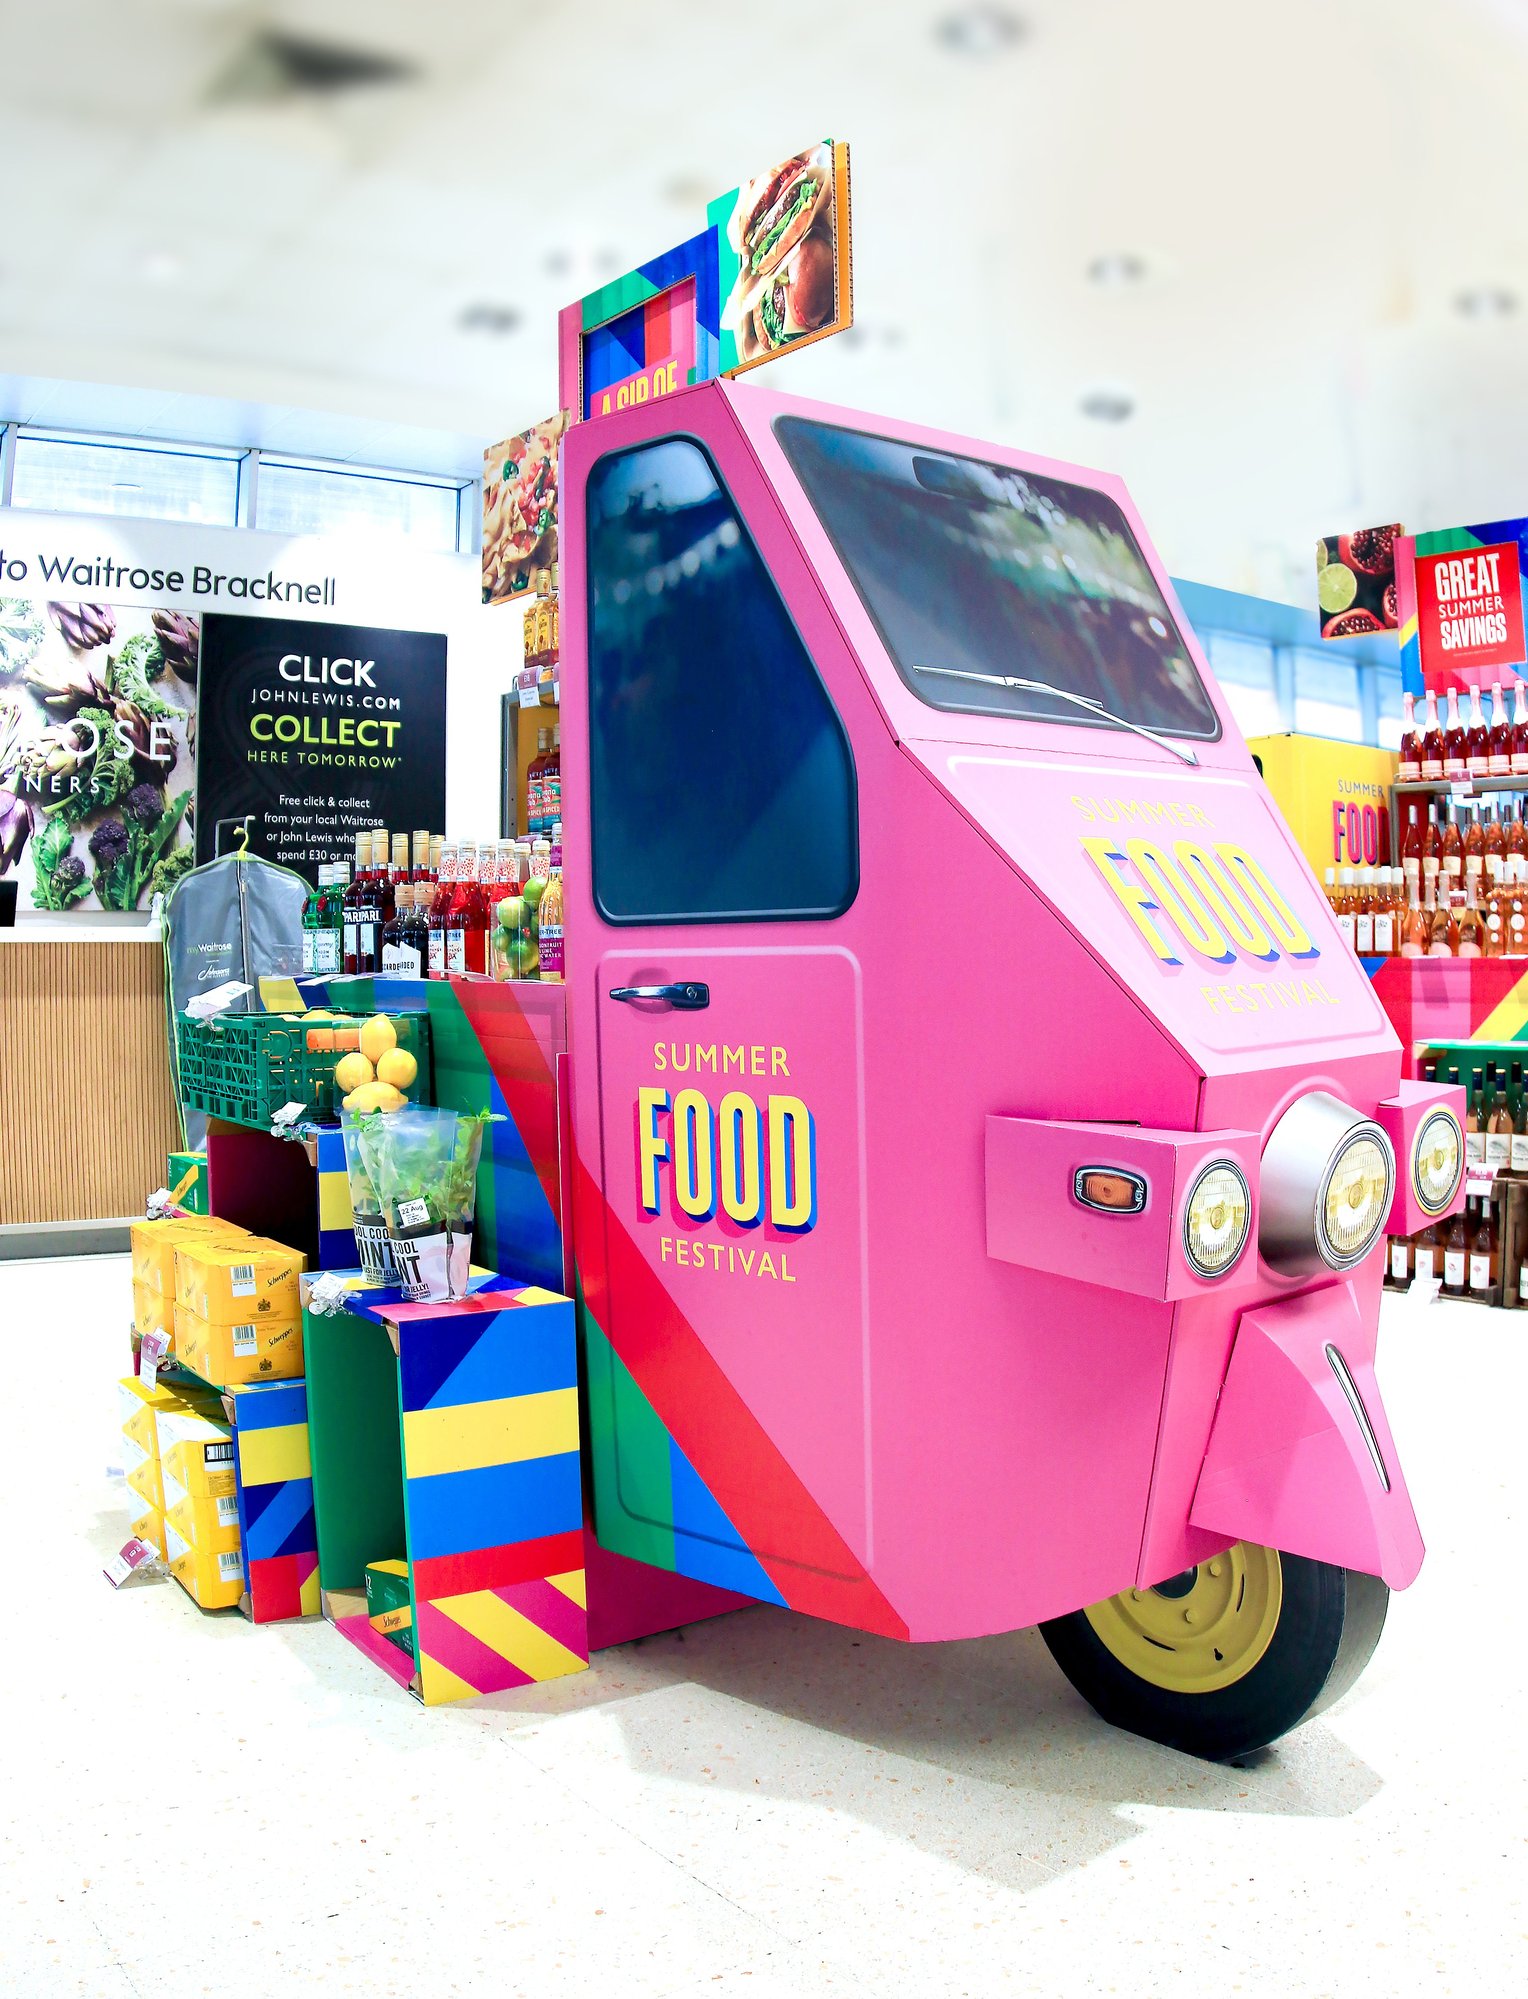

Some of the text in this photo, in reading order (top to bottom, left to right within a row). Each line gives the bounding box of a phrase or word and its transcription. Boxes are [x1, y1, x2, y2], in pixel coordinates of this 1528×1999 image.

[0, 549, 336, 606] to Waitrose Bracknell
[1434, 553, 1499, 601] GREAT
[1438, 595, 1504, 619] SUMMER
[1440, 612, 1507, 650] SAVINGS
[278, 654, 376, 688] CLICK
[251, 688, 401, 711] JOHNLEWIS.COM
[61, 717, 171, 763] OSE
[250, 713, 402, 748] COLLECT
[247, 750, 289, 764] HERE
[279, 794, 370, 809] Free click & collect
[1338, 779, 1384, 798] SUMMER
[264, 812, 384, 826] from your local Waitrose
[1071, 795, 1217, 829] SUMMER
[280, 831, 302, 844] John
[305, 832, 332, 843] Lewis
[335, 833, 356, 843] whe
[1332, 800, 1391, 867] FOOD
[276, 850, 356, 862] spend £30 or mo
[1078, 836, 1321, 966] FOOD
[1199, 978, 1342, 1015] FESTIVAL
[653, 1042, 791, 1077] SUMMER
[636, 1086, 818, 1236] FOOD
[369, 1227, 389, 1240] COO
[660, 1236, 797, 1282] FESTIVAL
[267, 1267, 292, 1288] Schweppes
